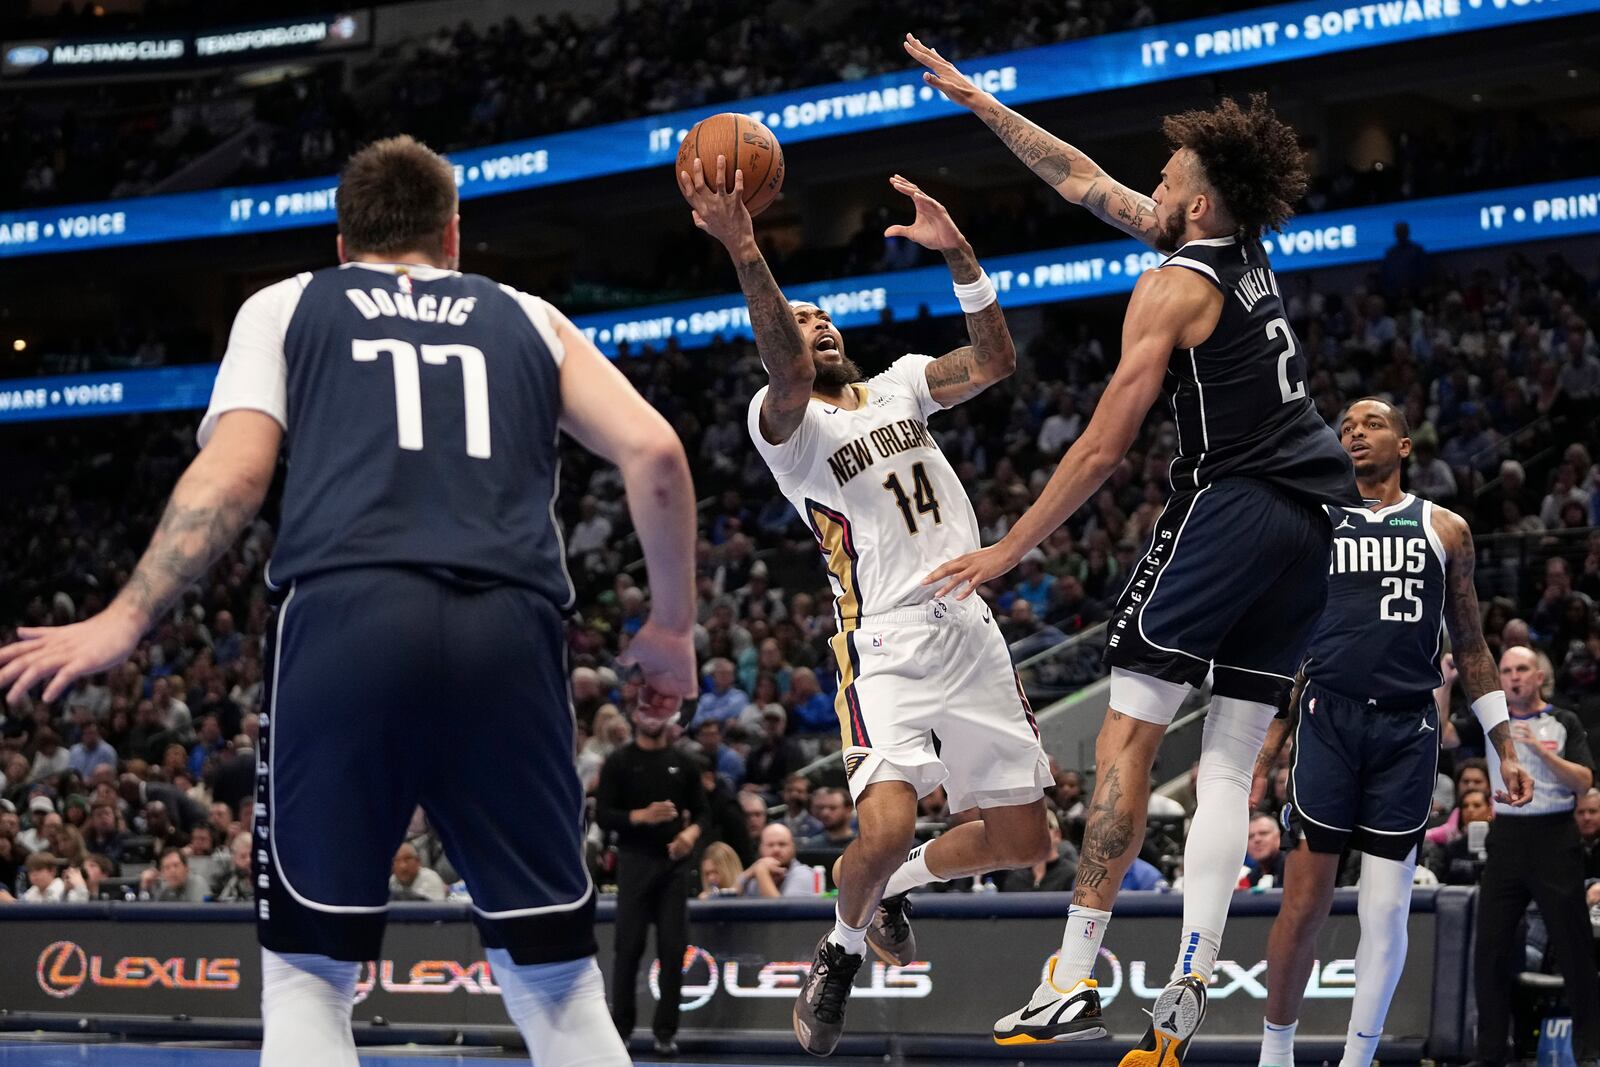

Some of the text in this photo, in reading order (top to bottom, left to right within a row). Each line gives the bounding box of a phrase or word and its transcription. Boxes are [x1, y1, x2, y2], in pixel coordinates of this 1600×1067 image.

[1141, 0, 1462, 67] IT PRINT SOFTWARE
[52, 42, 137, 65] MUSTANG
[783, 84, 916, 129] SOFTWARE
[649, 127, 674, 153] IT
[481, 149, 549, 182] VOICE
[58, 211, 126, 239] VOICE
[230, 198, 254, 221] IT
[1480, 192, 1600, 231] IT PRIN
[1277, 224, 1357, 255] VOICE
[1034, 257, 1104, 289] PRINT
[818, 287, 886, 316] VOICE
[1234, 267, 1271, 313] LIVELY
[613, 316, 674, 344] PRINT
[1265, 317, 1306, 404] 2
[0, 382, 123, 411] WARE VOICE
[351, 338, 491, 460] 77
[827, 437, 874, 488] NEW
[882, 461, 943, 536] 14
[1389, 517, 1419, 527] chime
[1329, 537, 1426, 575] MAVS
[1380, 577, 1424, 622] 25
[91, 955, 240, 989] LEXUS
